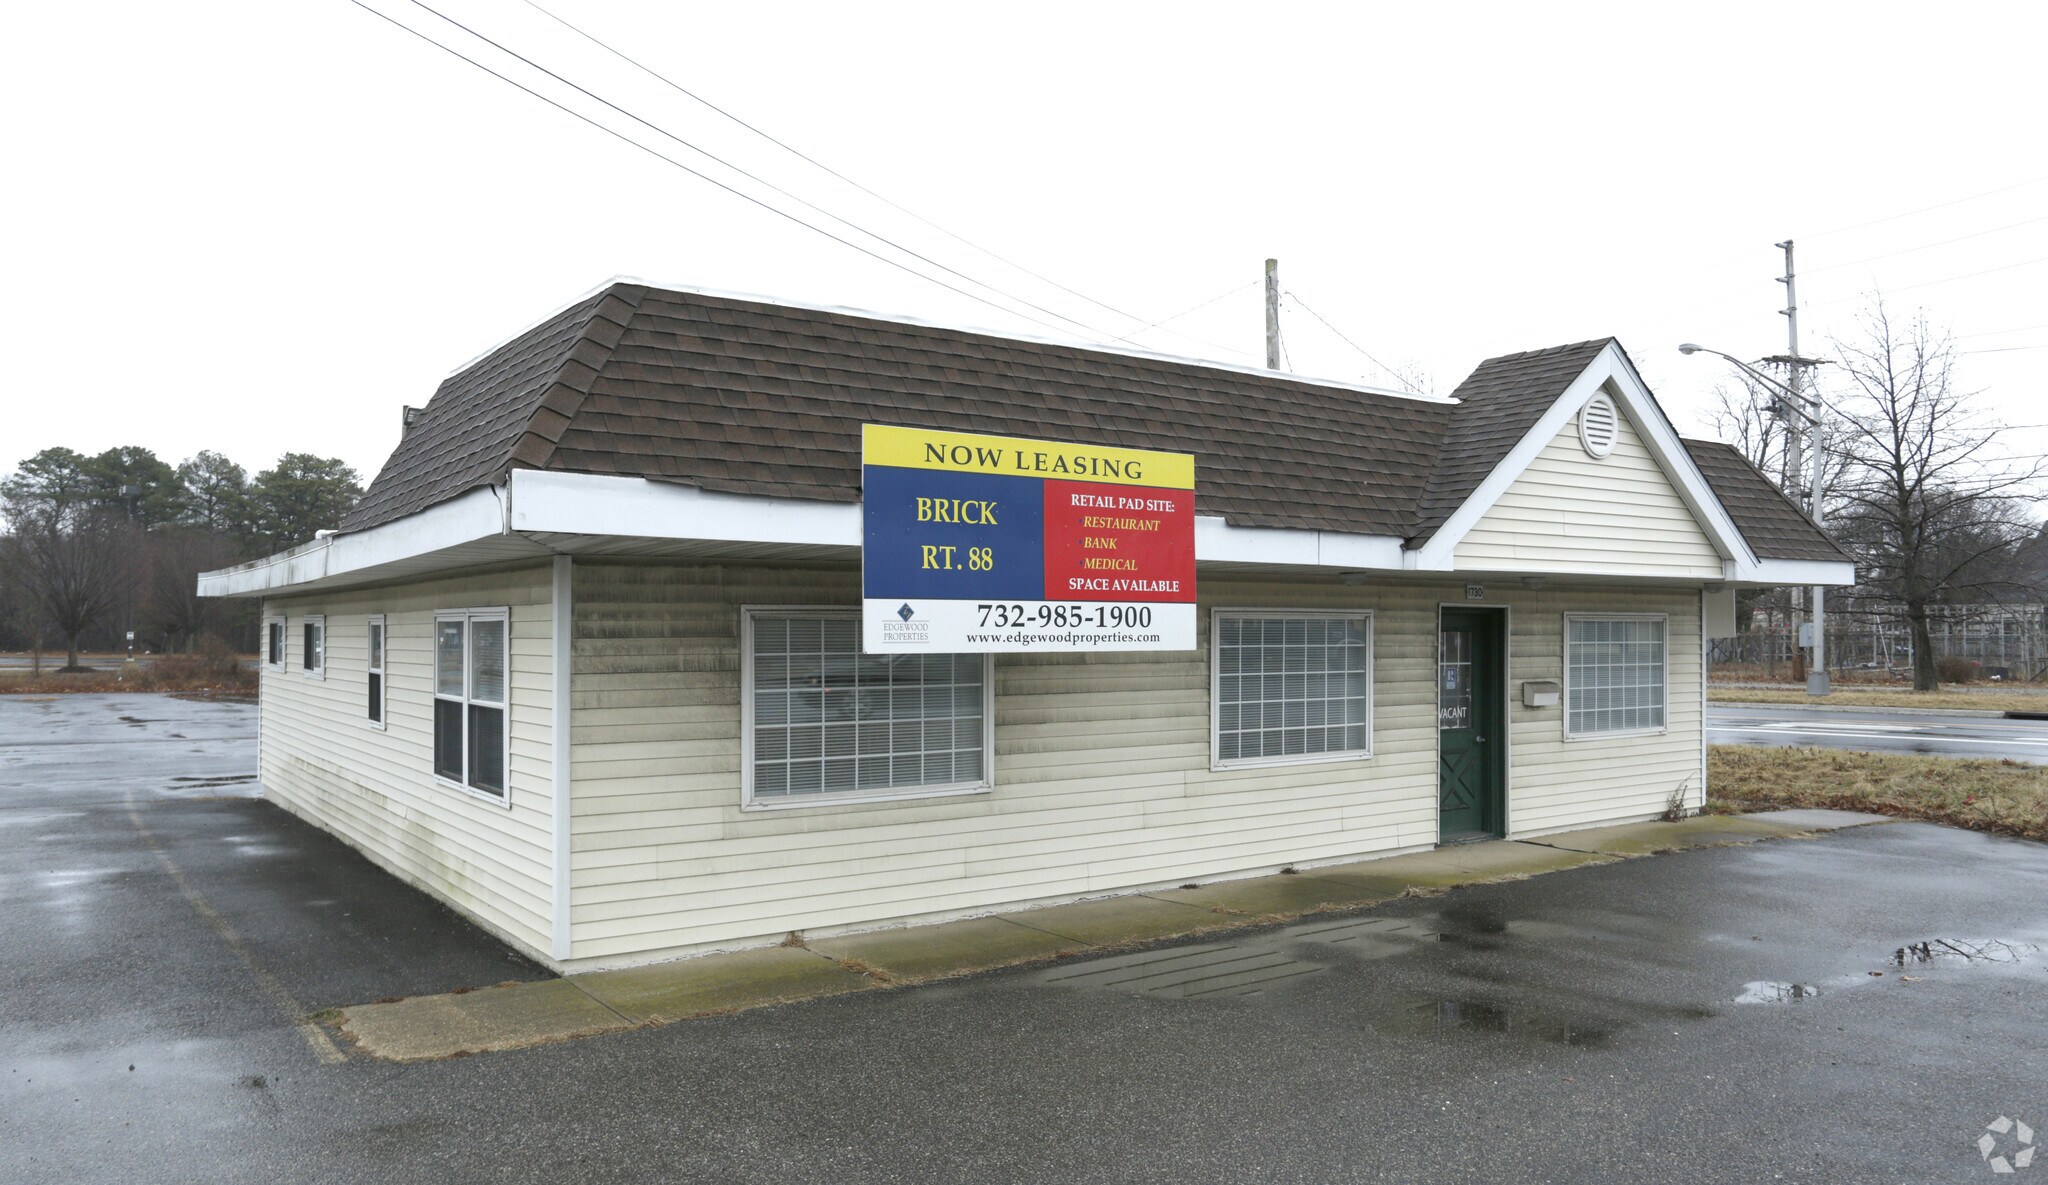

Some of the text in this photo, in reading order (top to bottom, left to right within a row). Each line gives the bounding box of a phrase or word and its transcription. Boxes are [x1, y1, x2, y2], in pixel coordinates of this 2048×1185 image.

[924, 443, 1143, 479] NOW LEASING
[1071, 494, 1175, 512] RETAIL PAD SITE:
[916, 497, 998, 525] BRICK
[1084, 516, 1161, 531] RESTAURANT
[1084, 537, 1117, 549] BANK
[921, 545, 993, 571] RT. 88
[1084, 558, 1138, 571] MEDICAL
[1069, 578, 1180, 592] SPACE AVAILABLE
[1467, 587, 1483, 597] 1730
[977, 604, 1152, 628] 732-985-1900
[883, 623, 929, 631] EDGEWOOD
[883, 632, 929, 641] PROPERTIES
[966, 631, 1160, 646] www.edgewoodproperties.com
